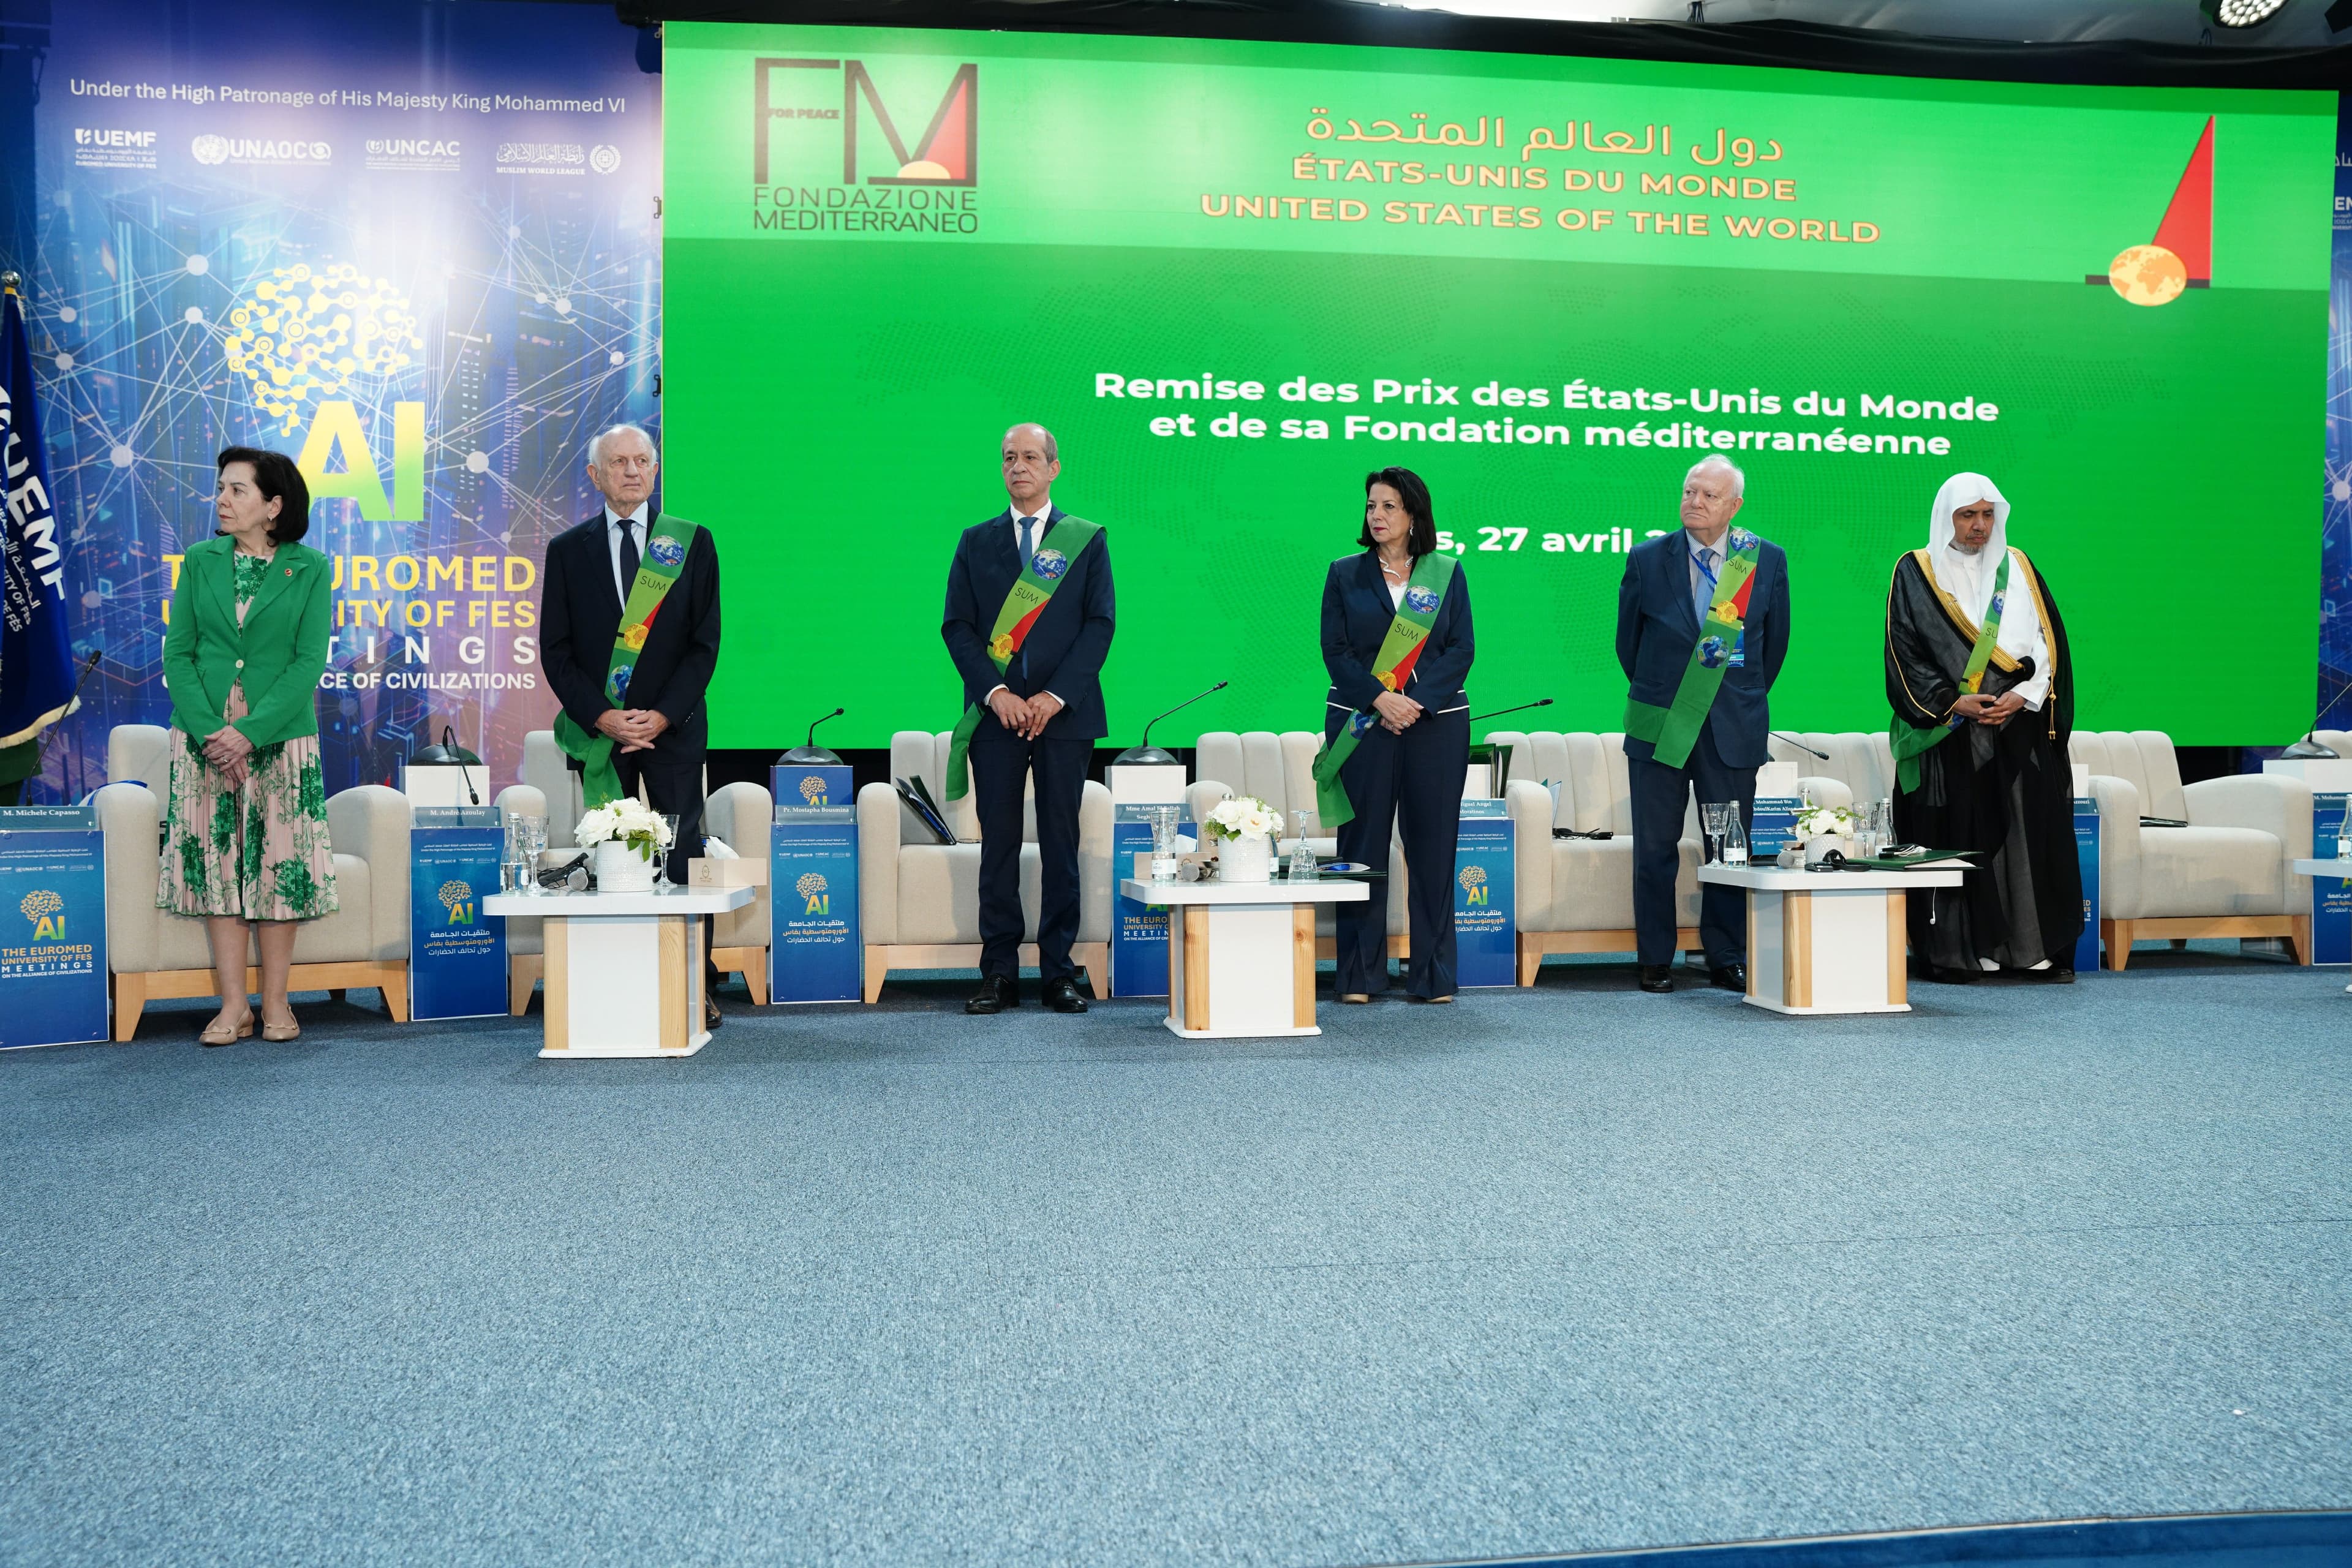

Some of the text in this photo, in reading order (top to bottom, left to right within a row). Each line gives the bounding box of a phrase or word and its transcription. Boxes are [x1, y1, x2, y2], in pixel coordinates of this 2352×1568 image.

[70, 78, 625, 113] Under the High Patronage of His Majesty King Mohammed VI
[768, 108, 840, 119] FOR PEACE
[94, 129, 157, 147] UEMF
[1306, 107, 1782, 168] دول العالم المتحدة
[230, 139, 306, 159] UNAOC
[386, 140, 461, 156] UNCAC
[1292, 152, 1796, 202] ÉTATS-UNIS DU MONDE
[754, 186, 977, 211] FONDAZIONE
[754, 209, 978, 233] MEDITERRANEO
[1200, 194, 1880, 244] UNITED STATES OF THE WORLD
[1095, 371, 1999, 422] Remise des Prix des États-Unis du Monde
[1148, 411, 1951, 456] et de sa Fondation méditerranéenne
[297, 401, 425, 522] AI
[1477, 527, 1529, 551] 27
[1541, 527, 1633, 553] avril
[331, 556, 536, 591] ROMED
[1728, 559, 1747, 575] SUM
[639, 575, 666, 592] SUM
[1014, 587, 1039, 605] SUM
[405, 600, 455, 627] OF
[469, 600, 536, 627] FES
[1395, 623, 1419, 642] SUM
[1985, 627, 1998, 639] SU
[326, 636, 536, 664] TINGS
[353, 673, 381, 689] OF
[386, 673, 536, 689] CIVILIZATIONS
[805, 895, 829, 915] AI
[1466, 886, 1488, 905] AI
[448, 903, 473, 925] AI
[1464, 916, 1506, 925] الأورومتوسطية
[33, 916, 66, 941] AI
[802, 926, 849, 935] الأورومتوسطية
[2, 944, 92, 957] THE EUROMED
[445, 937, 495, 947] الأورومتوسطية
[2, 956, 58, 965] UNIVERSITY
